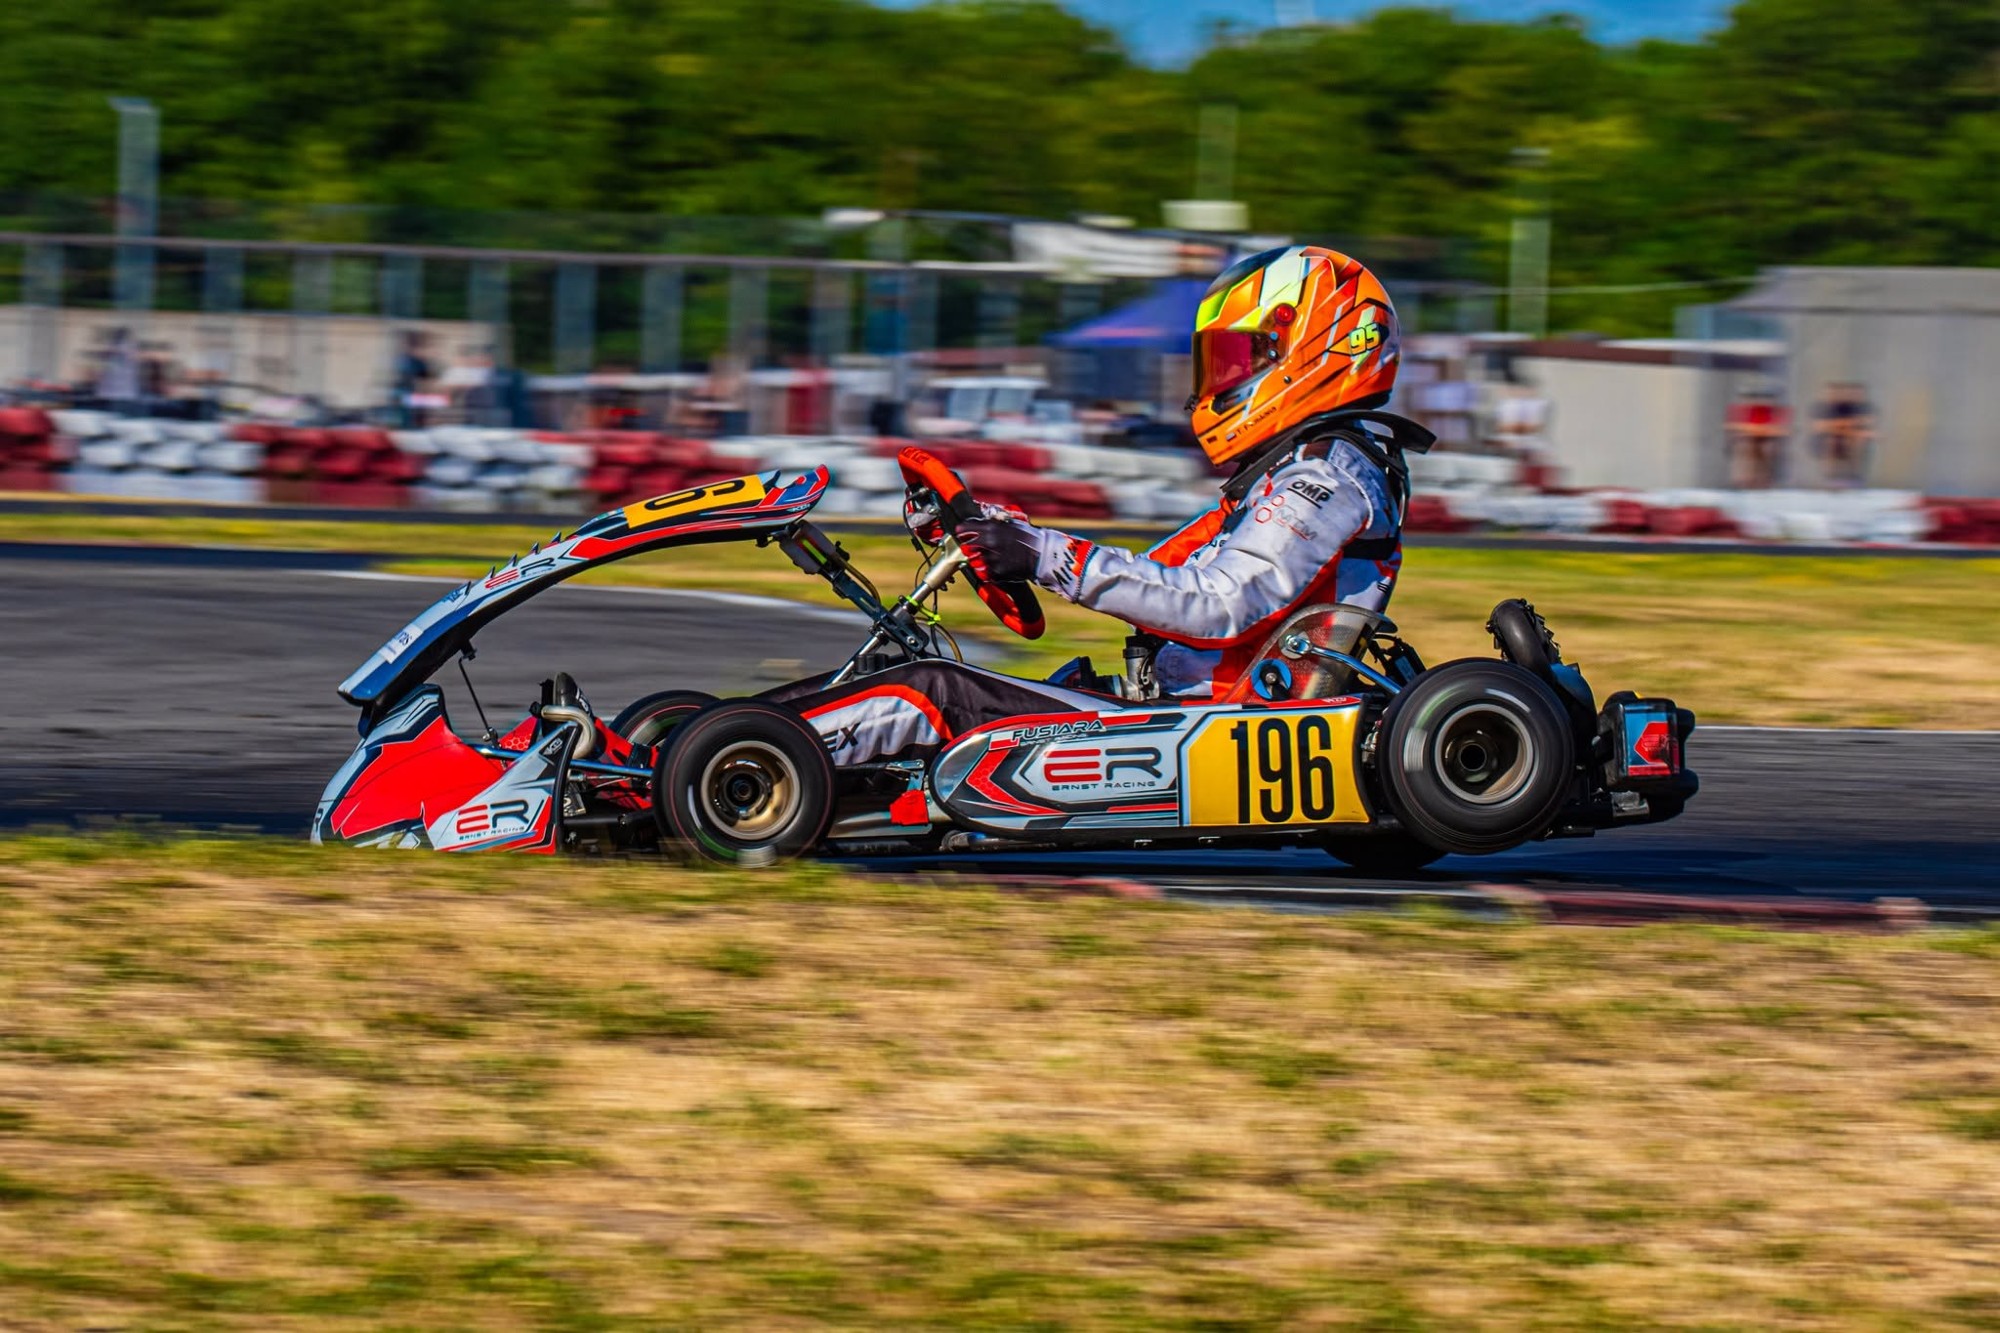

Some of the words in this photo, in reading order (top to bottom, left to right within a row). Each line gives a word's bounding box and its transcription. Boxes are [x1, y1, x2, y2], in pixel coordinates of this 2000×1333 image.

[1350, 322, 1381, 356] 95
[1292, 481, 1331, 502] OMP
[1012, 720, 1104, 741] FUSIARA
[1044, 746, 1163, 783] ER
[1231, 715, 1335, 824] 196
[1052, 783, 1099, 791] ERNST
[1104, 780, 1157, 789] RACING
[456, 799, 530, 834] ER
[459, 831, 488, 841] ERNST
[490, 825, 526, 835] RACING
